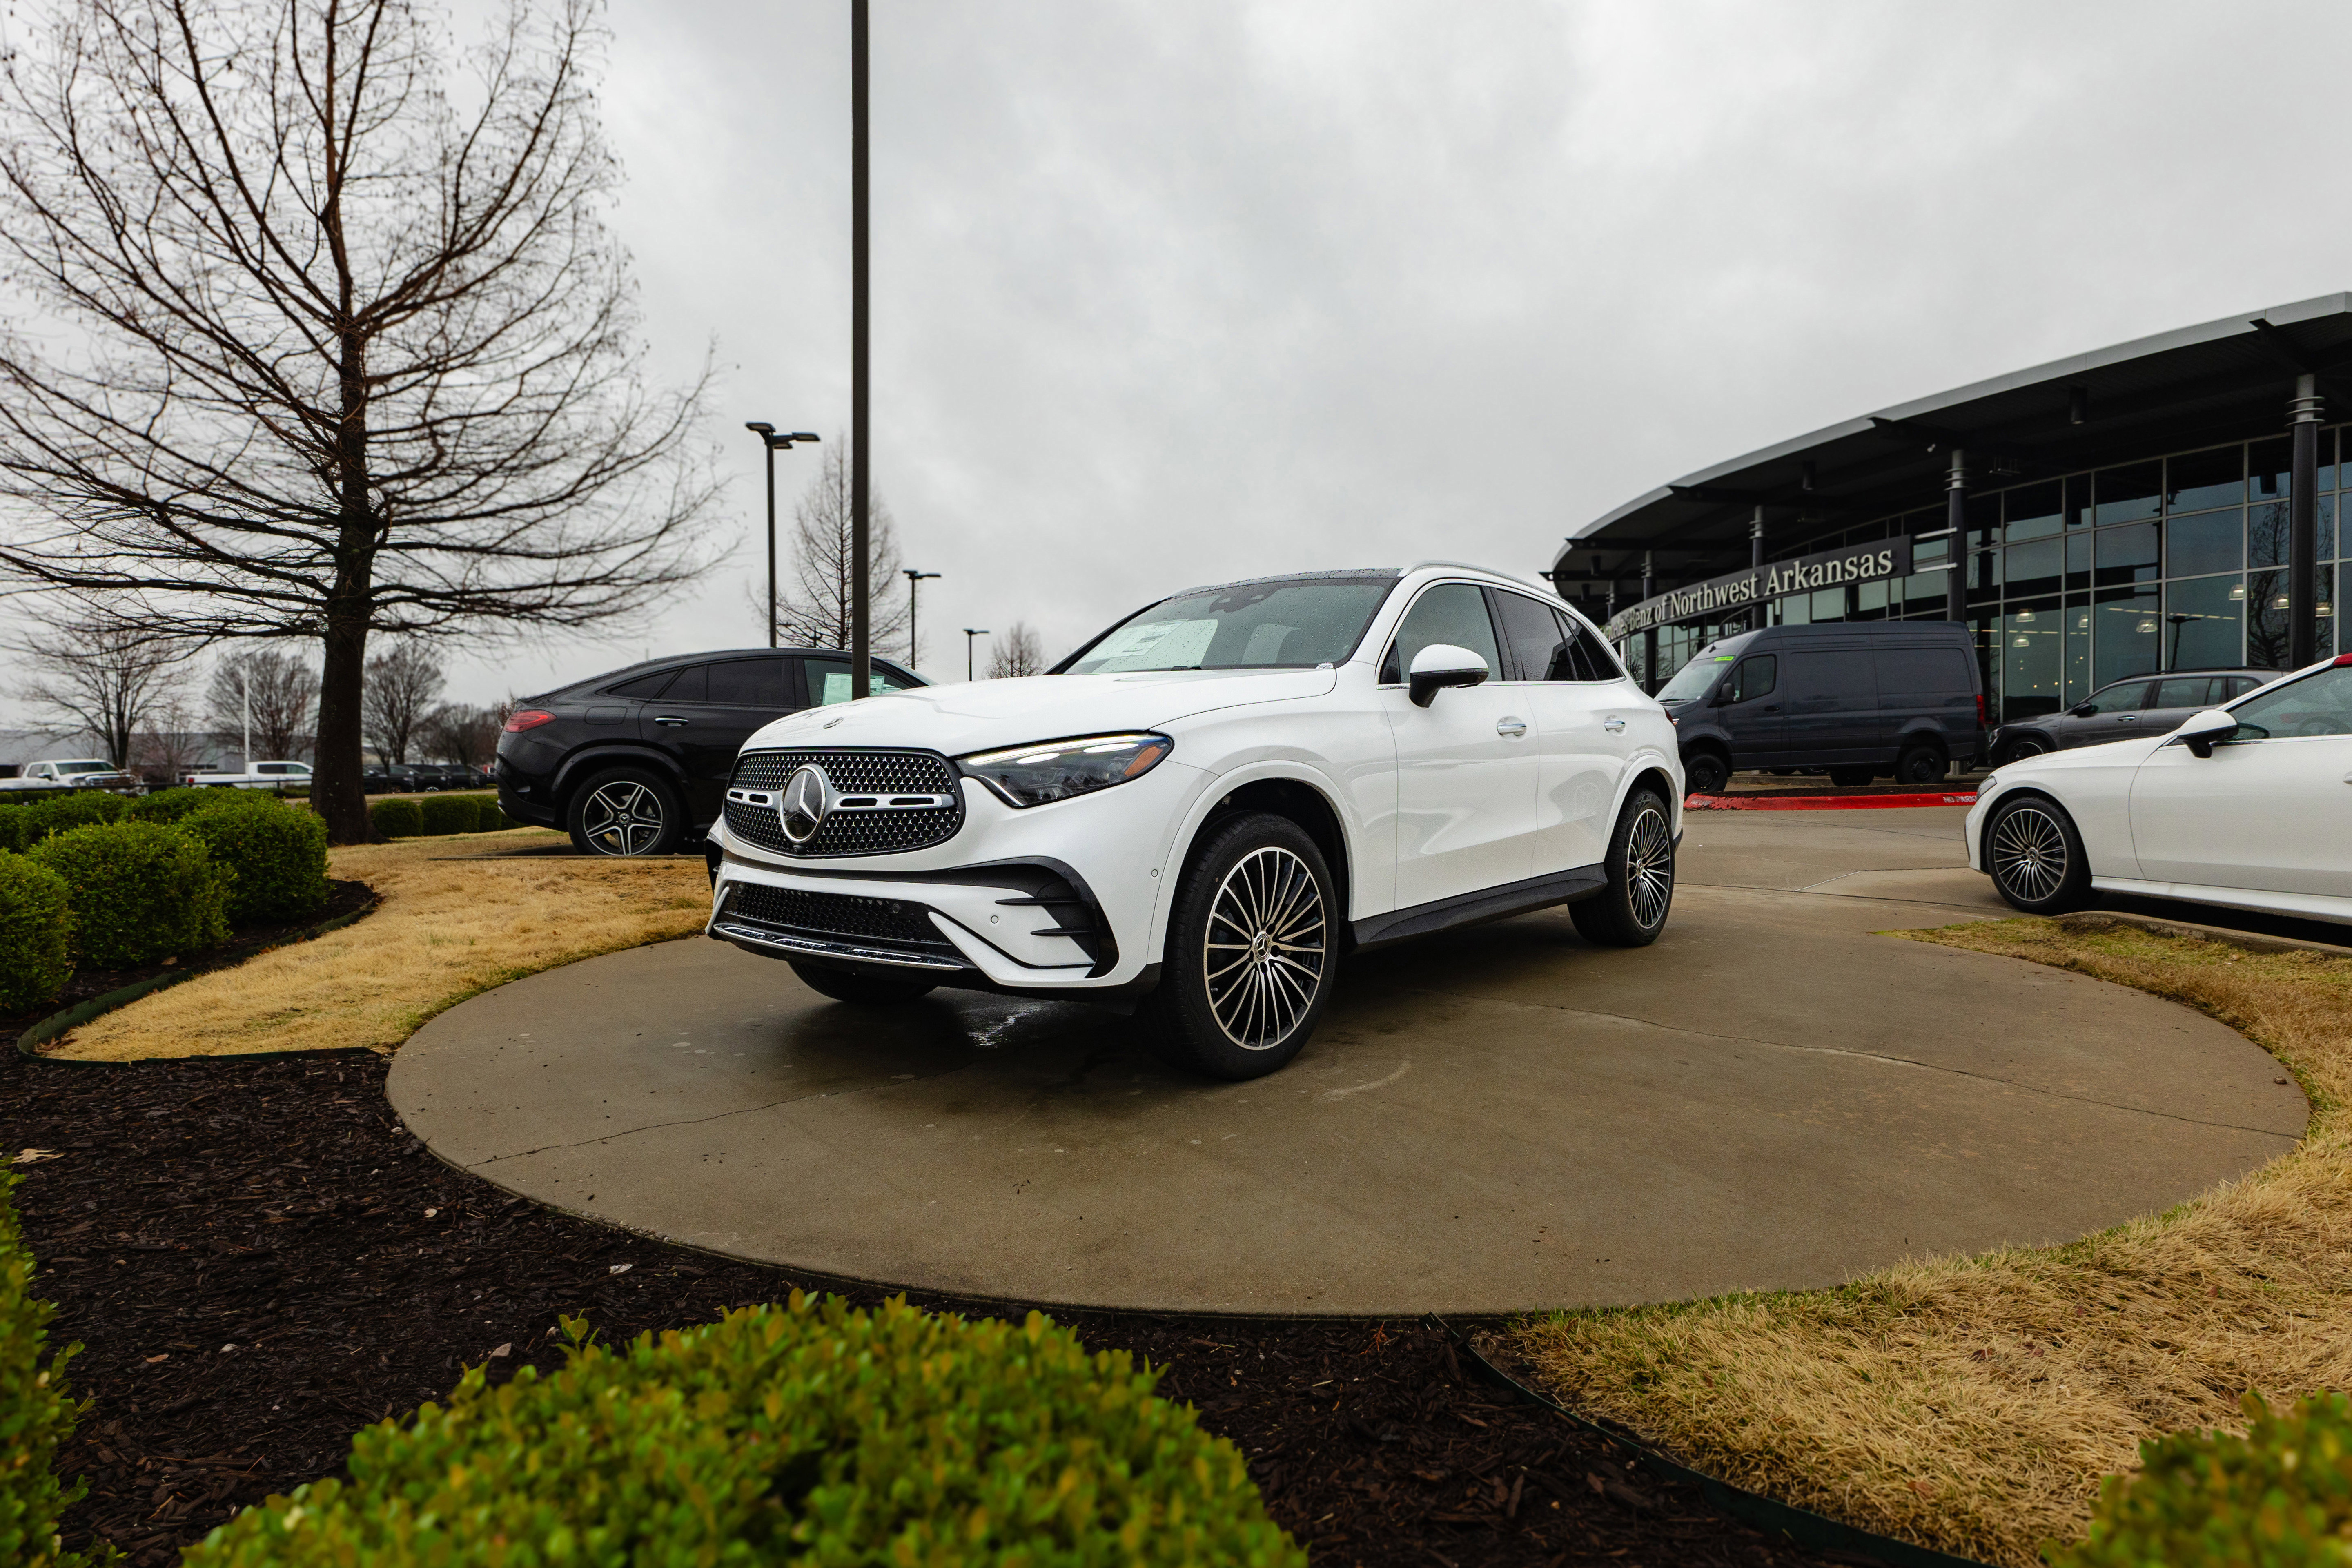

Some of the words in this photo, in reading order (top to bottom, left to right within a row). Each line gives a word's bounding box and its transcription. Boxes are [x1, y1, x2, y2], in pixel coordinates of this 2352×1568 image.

[1655, 595, 1667, 623] of
[1670, 572, 1758, 618] Northwest
[1764, 550, 1892, 596] Arkansas
